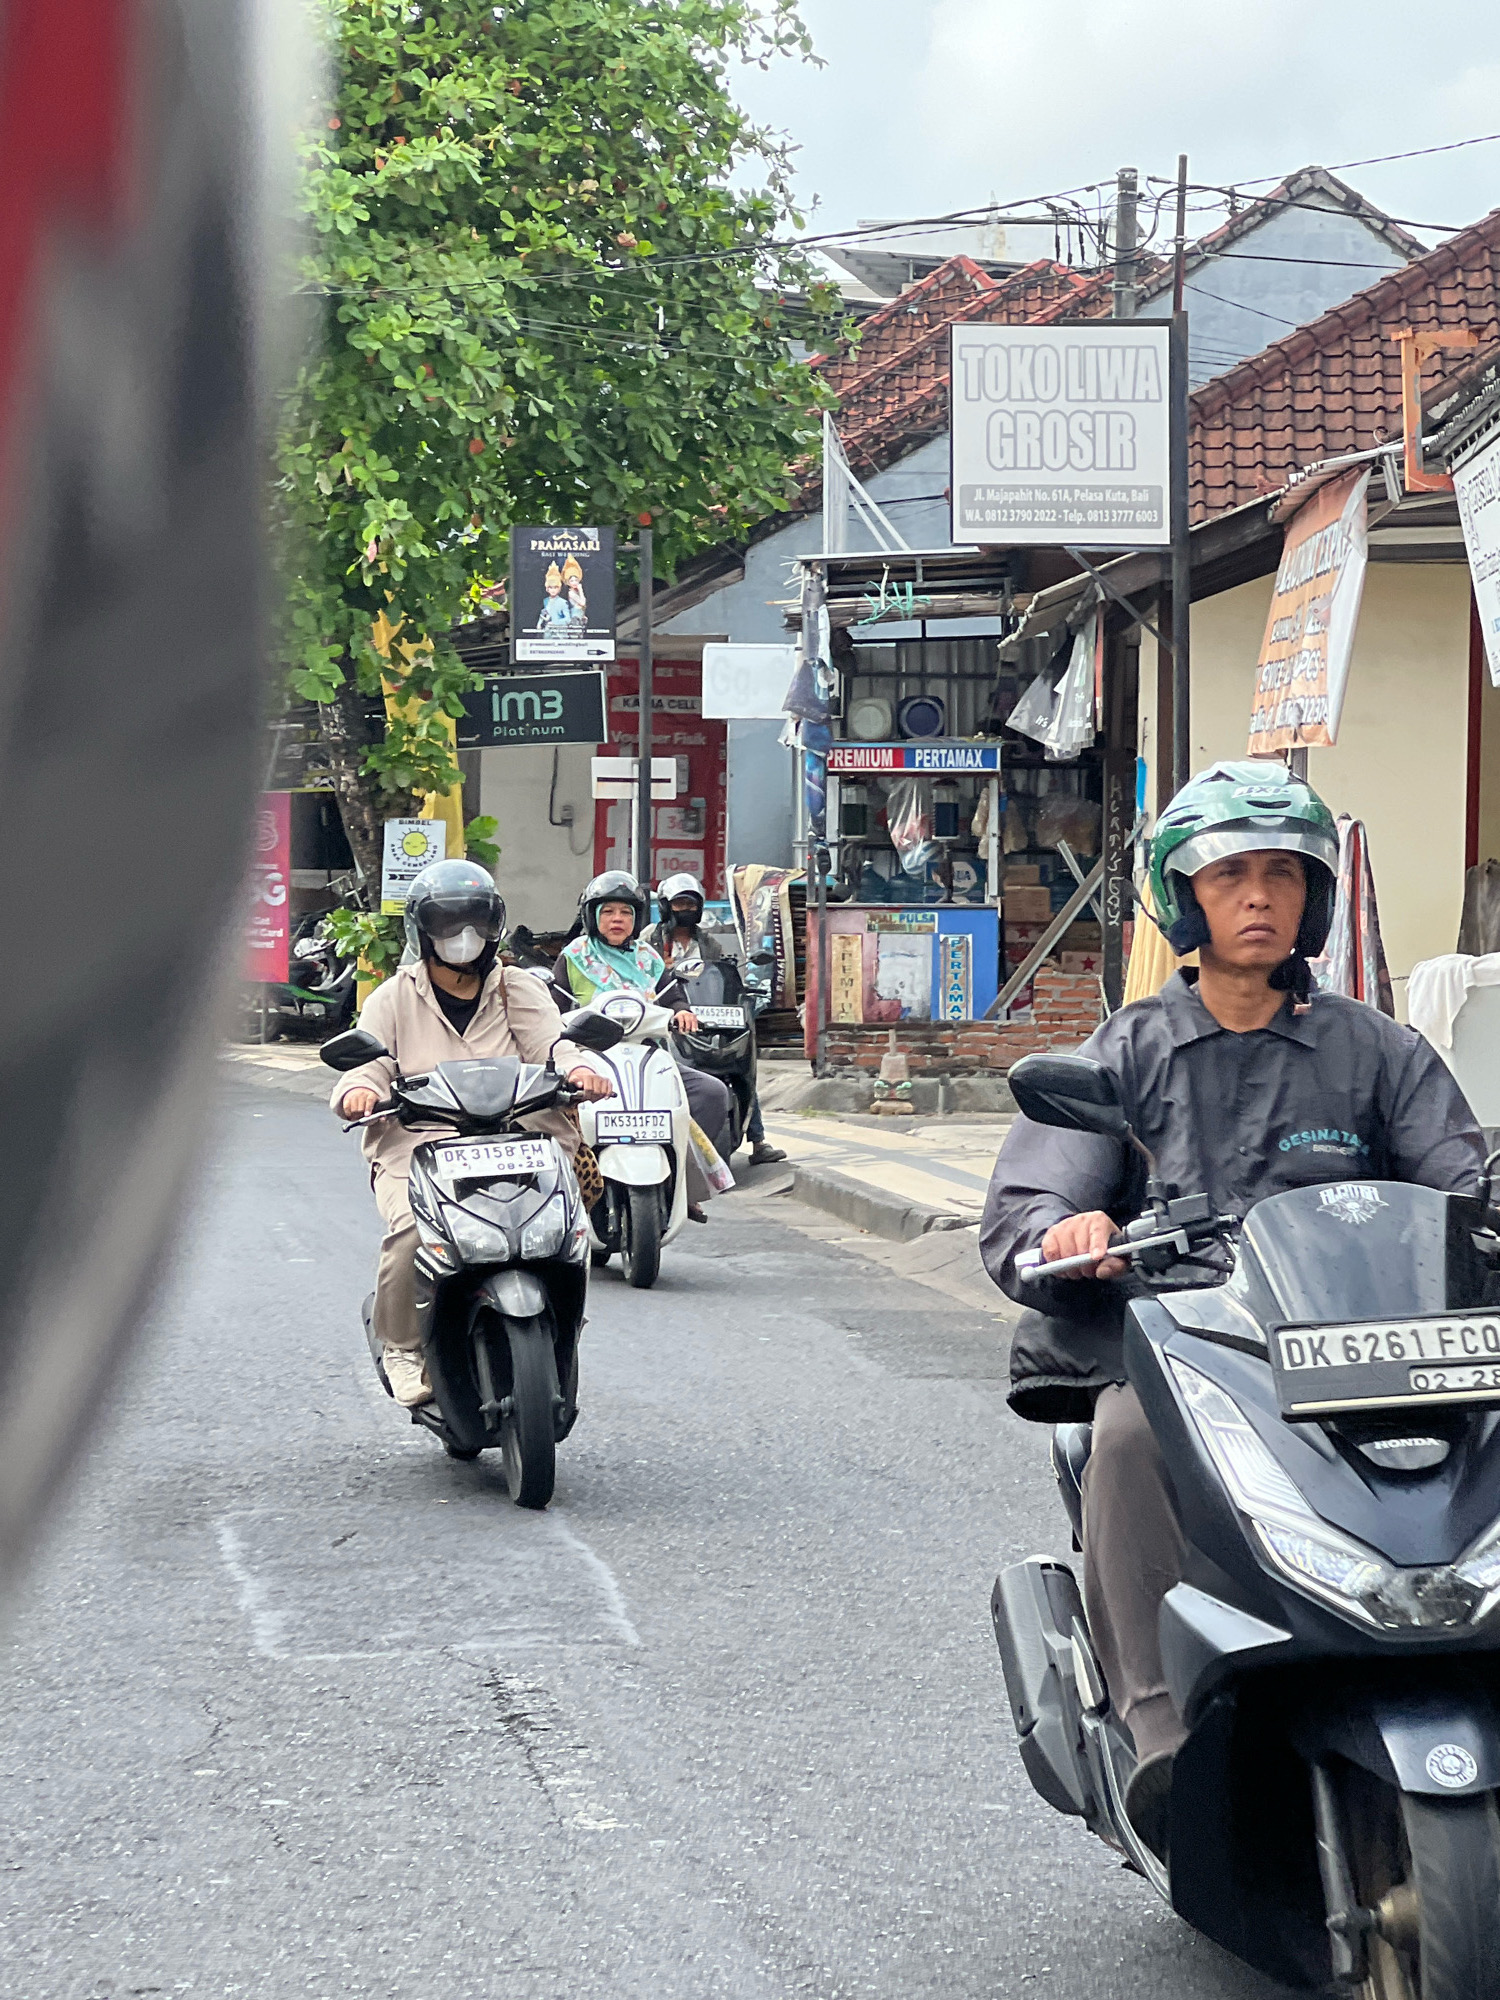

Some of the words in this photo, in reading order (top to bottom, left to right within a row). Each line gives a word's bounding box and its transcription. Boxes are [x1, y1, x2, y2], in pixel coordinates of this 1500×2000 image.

[959, 344, 1060, 402] TOKO
[1065, 345, 1162, 403] LIWA
[986, 409, 1136, 471] GROSIR
[986, 489, 1033, 504] Majapahit
[1035, 490, 1050, 502] No.
[1052, 490, 1072, 503] 61A,
[1074, 490, 1103, 502] Pelasa
[1105, 490, 1129, 504] Kuta,
[1131, 490, 1149, 502] Bali
[965, 509, 983, 522] WA.
[985, 509, 1008, 522] 0812
[1010, 509, 1033, 522] 3790
[1034, 509, 1056, 522] 2022
[1064, 510, 1086, 525] Telp.
[1087, 510, 1110, 523] 0813
[1112, 510, 1135, 523] 3777
[1136, 510, 1158, 523] 6003
[530, 540, 600, 551] PRAMASARI
[667, 698, 697, 709] CELL
[827, 748, 893, 768] PREMIUM
[915, 748, 983, 768] PERTAMAX
[662, 858, 699, 871] 10GB
[899, 913, 936, 923] PULSA
[444, 1149, 467, 1162] DK
[471, 1146, 515, 1160] 3158
[520, 1144, 543, 1156] FM
[1286, 1335, 1331, 1368] DK
[1342, 1329, 1425, 1363] 6261
[1374, 1437, 1441, 1450] HONDA
